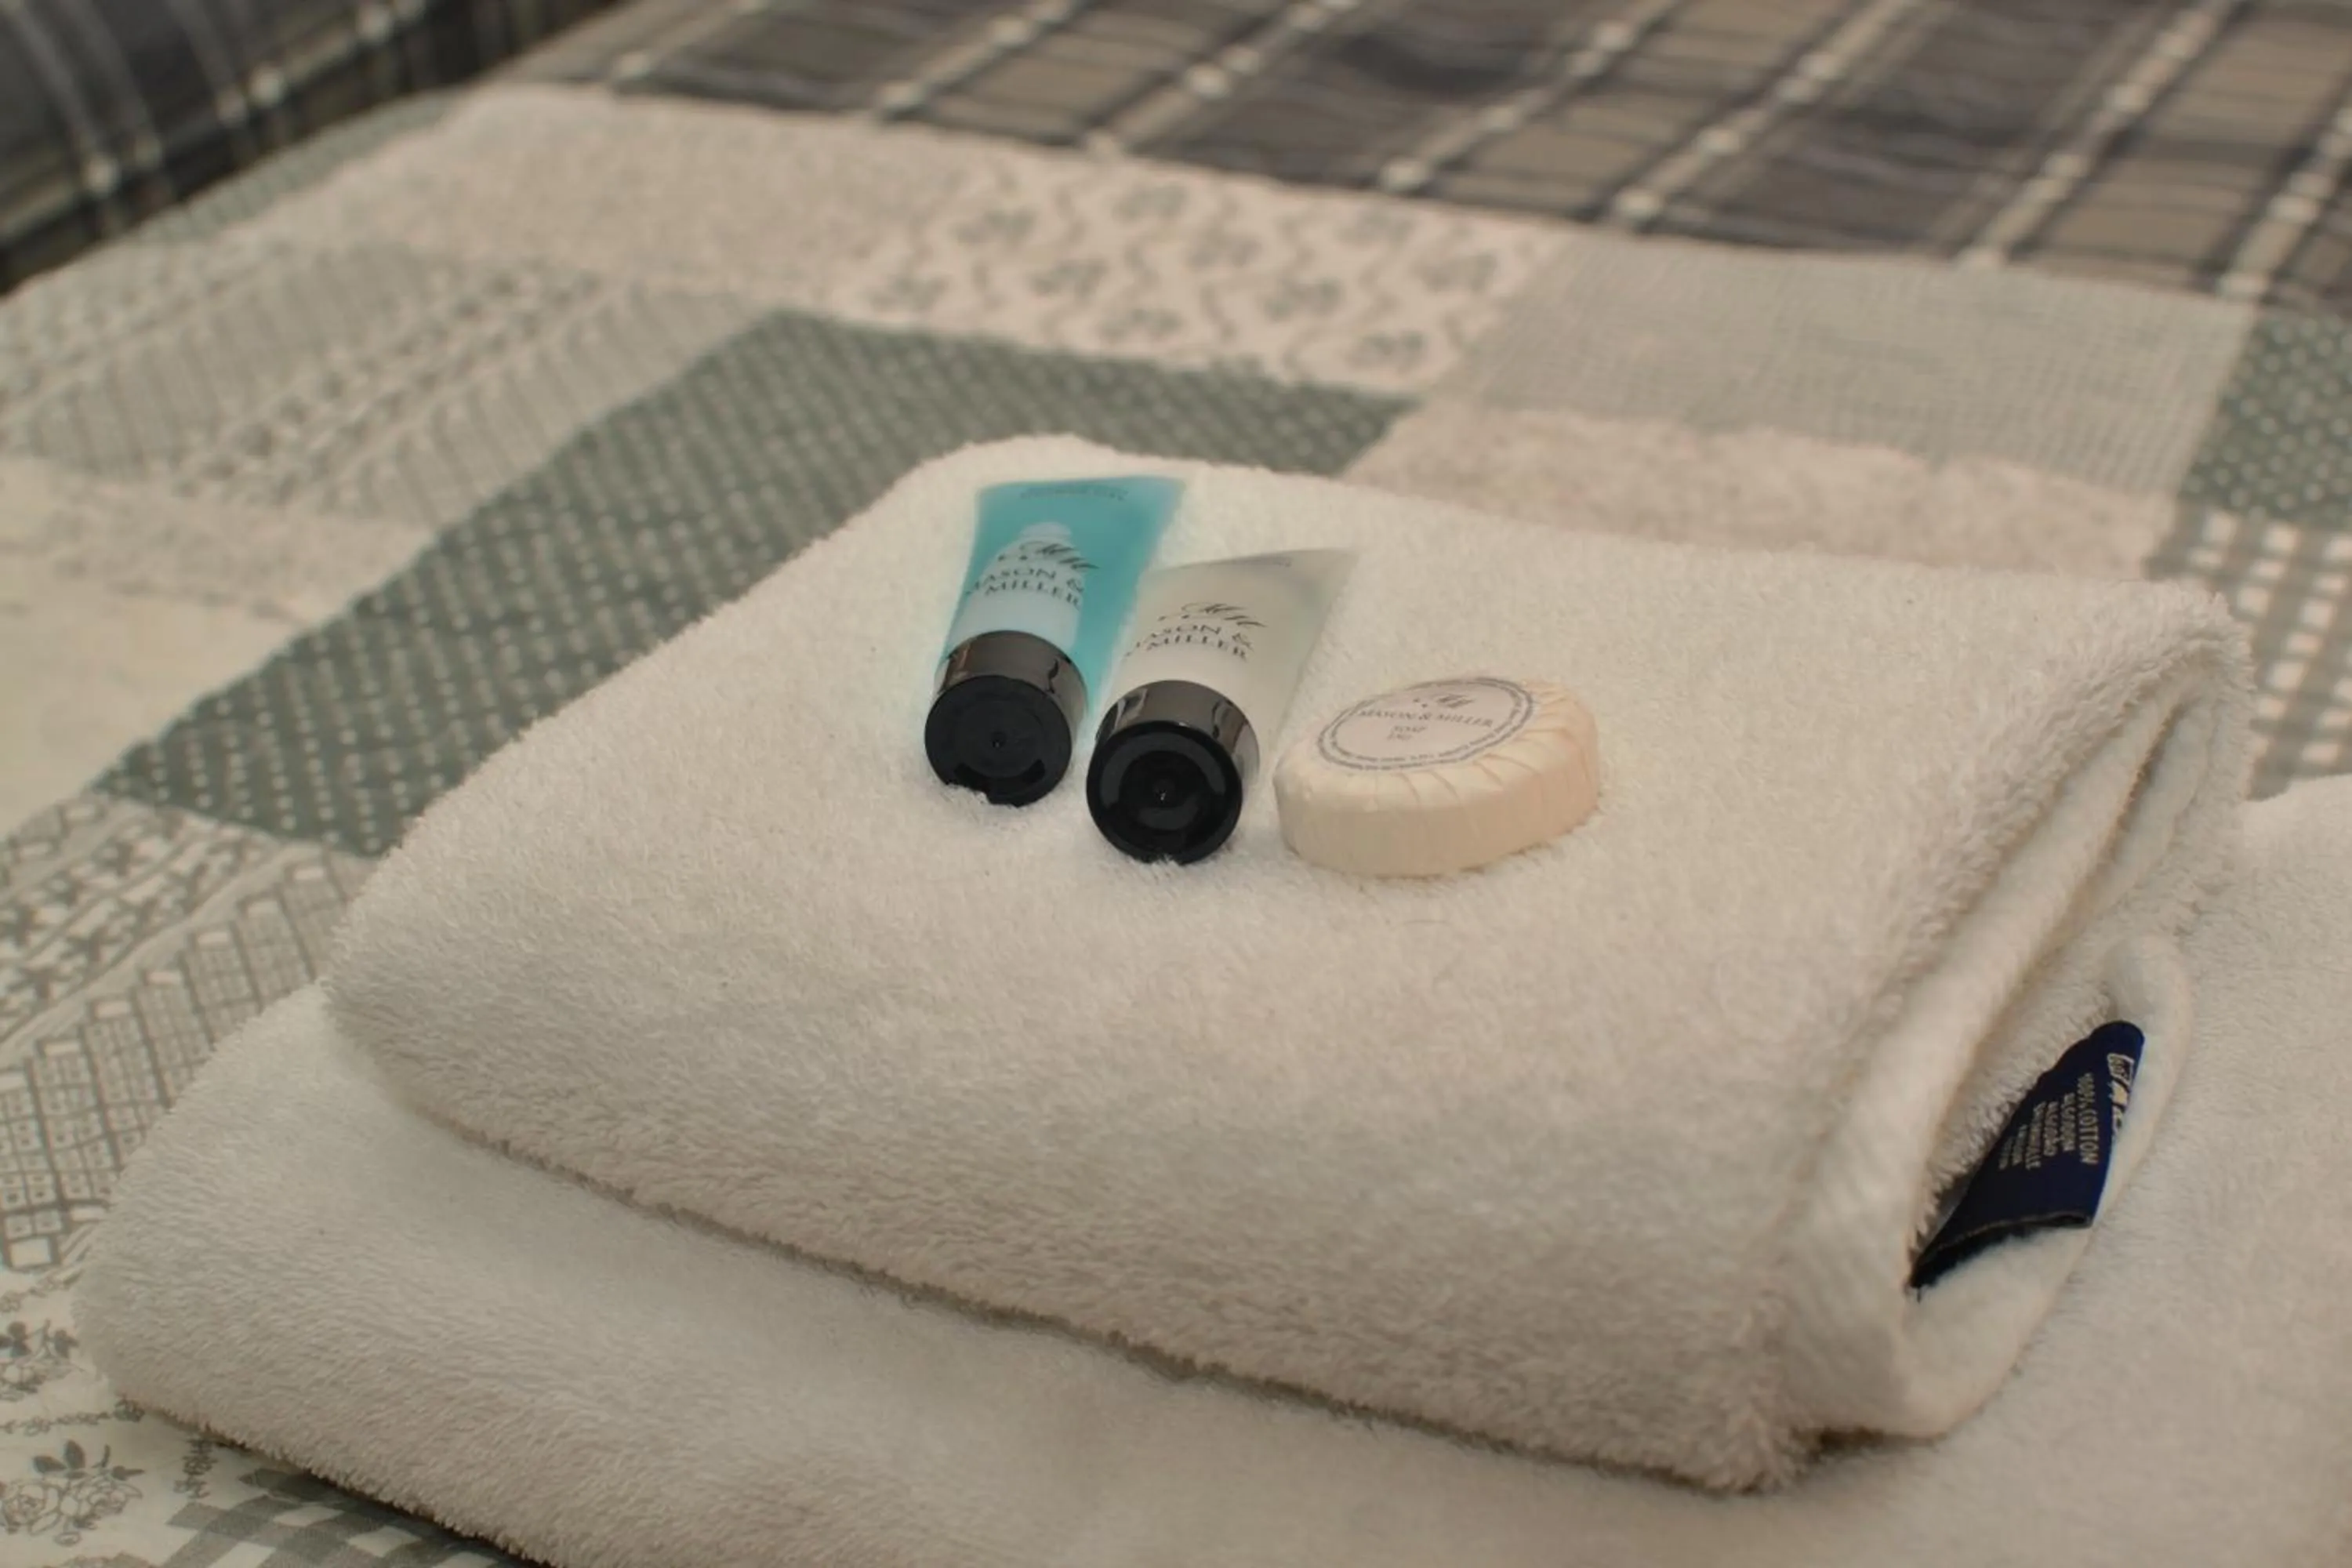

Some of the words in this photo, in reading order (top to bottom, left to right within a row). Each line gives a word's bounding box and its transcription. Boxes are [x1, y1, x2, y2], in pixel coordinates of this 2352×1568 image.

[964, 568, 1057, 597] MASON
[1066, 578, 1084, 595] &
[985, 579, 1081, 612] MILLER
[1145, 633, 1248, 662] MILLER
[1232, 633, 1254, 652] &
[1417, 711, 1433, 721] &
[2078, 1108, 2100, 1165] COTTON
